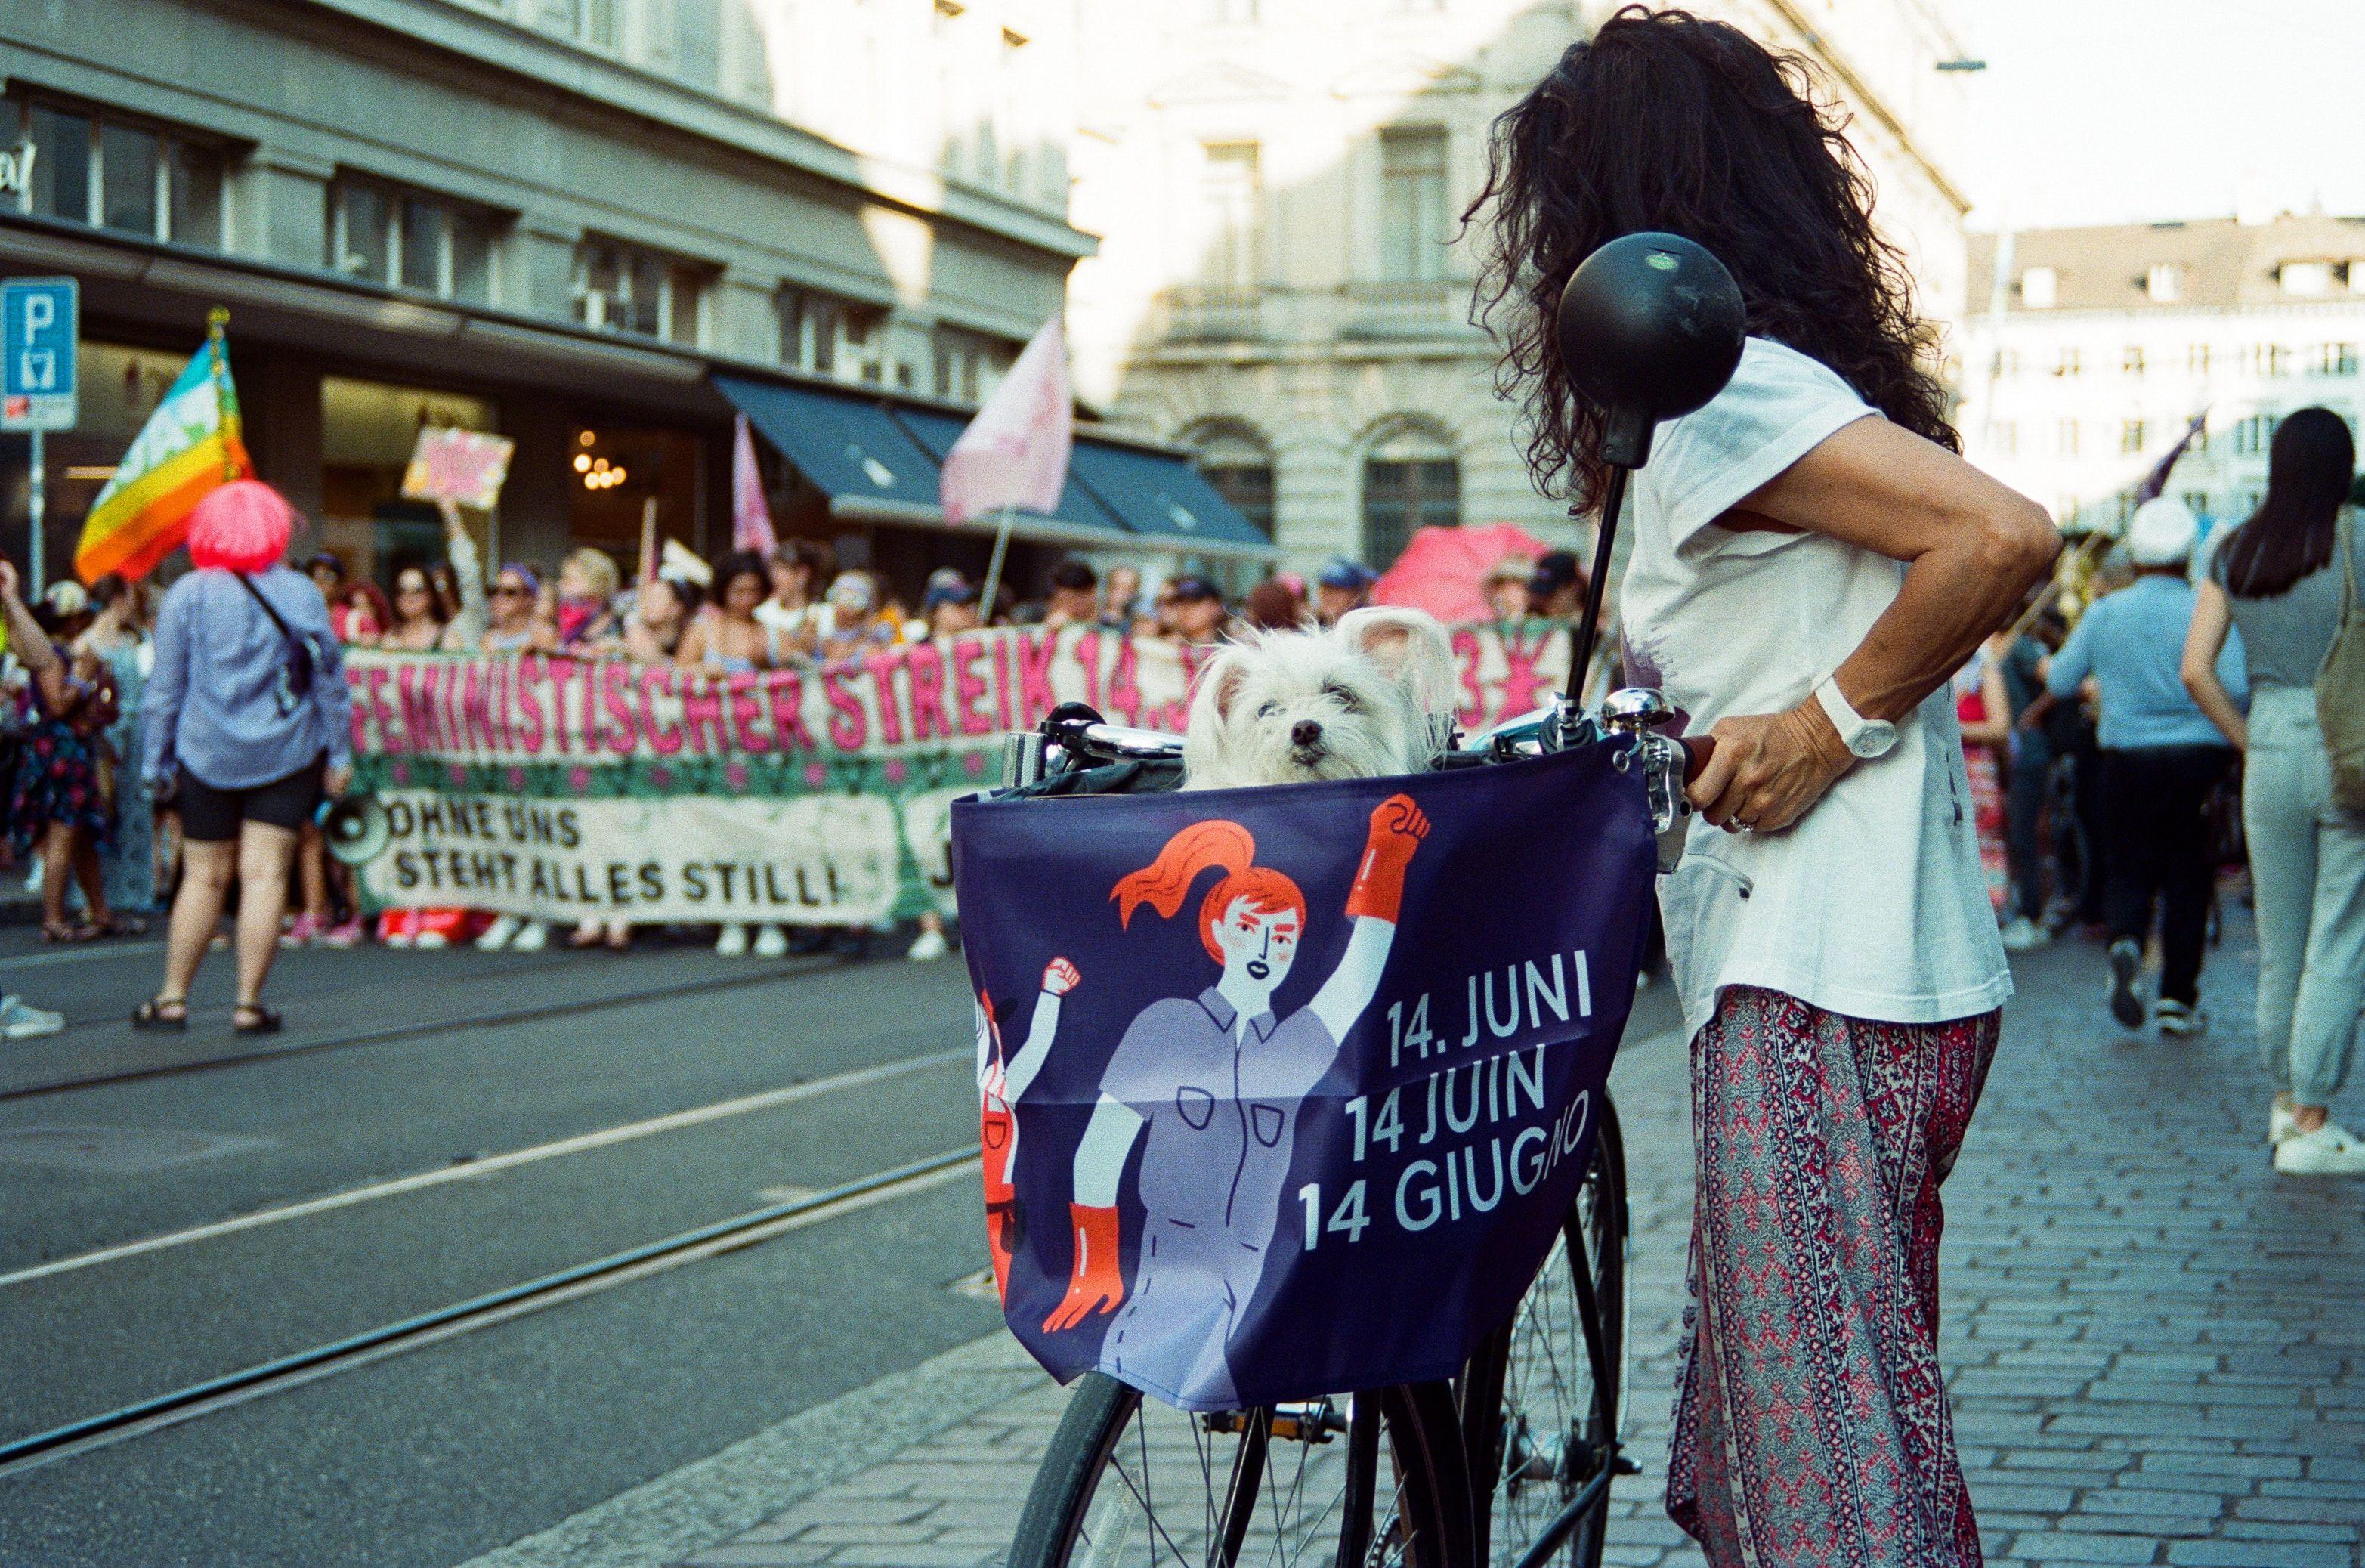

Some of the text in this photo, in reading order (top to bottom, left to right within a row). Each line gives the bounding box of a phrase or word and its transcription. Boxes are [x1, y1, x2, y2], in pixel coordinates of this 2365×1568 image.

[25, 293, 54, 346] P
[345, 654, 815, 753] FEMINISTISCHER
[823, 632, 1057, 750] STREIK
[388, 799, 580, 849] OHNE UNS
[394, 849, 839, 907] STEHT ALLES STILL!
[1387, 949, 1591, 1068] 14. JUNI
[1345, 1043, 1545, 1161] 14 JUIN
[1299, 1090, 1589, 1251] 14 GIUGNO
